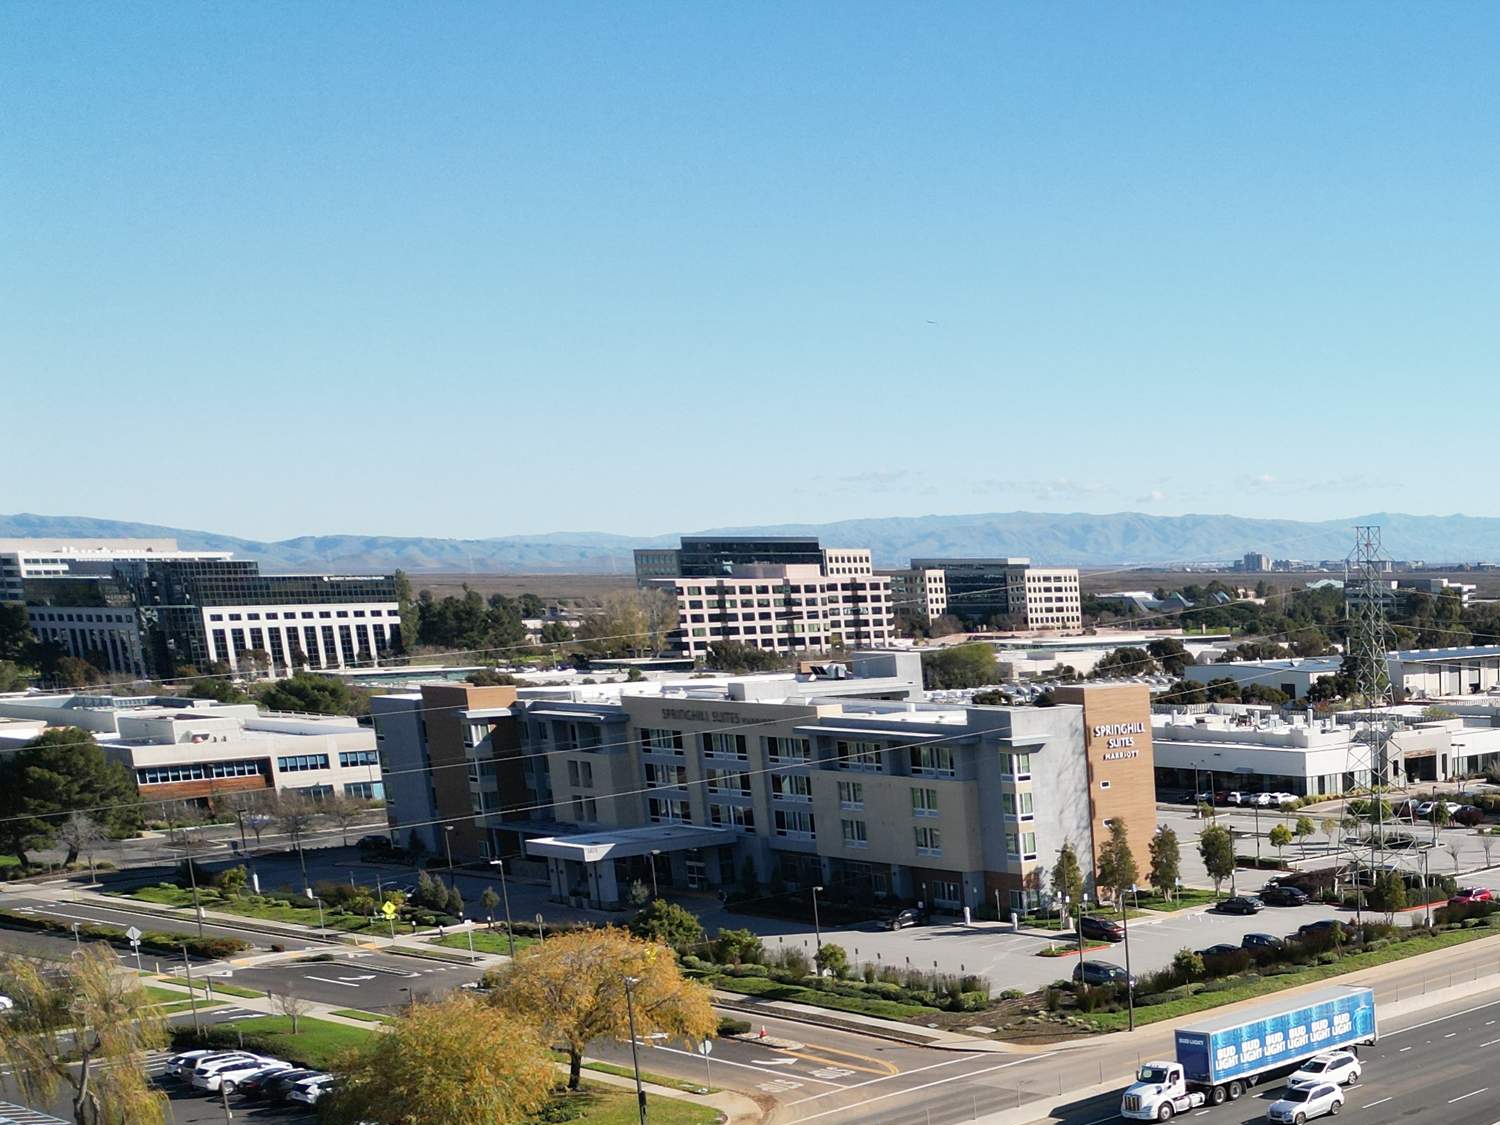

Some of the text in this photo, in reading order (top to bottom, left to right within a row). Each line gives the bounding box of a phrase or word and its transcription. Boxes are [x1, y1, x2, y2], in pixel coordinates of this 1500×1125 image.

[1095, 722, 1145, 736] SPRINGHILL
[1108, 737, 1134, 748] SUITES
[1105, 750, 1139, 760] MARRIOTT
[1311, 1019, 1328, 1032] BUD
[1333, 1013, 1350, 1026] BUD
[1288, 1025, 1306, 1039] BUD
[1310, 1027, 1330, 1042] LIGHT
[1332, 1021, 1352, 1035] LIGHT
[1241, 1038, 1260, 1053] BUD
[1265, 1032, 1284, 1046] BUD
[1287, 1034, 1309, 1049] LIGHT
[1216, 1045, 1236, 1060] BUD
[1240, 1047, 1262, 1063] LIGHT
[1264, 1040, 1286, 1056] LIGHT
[1215, 1054, 1238, 1071] LIGHT
